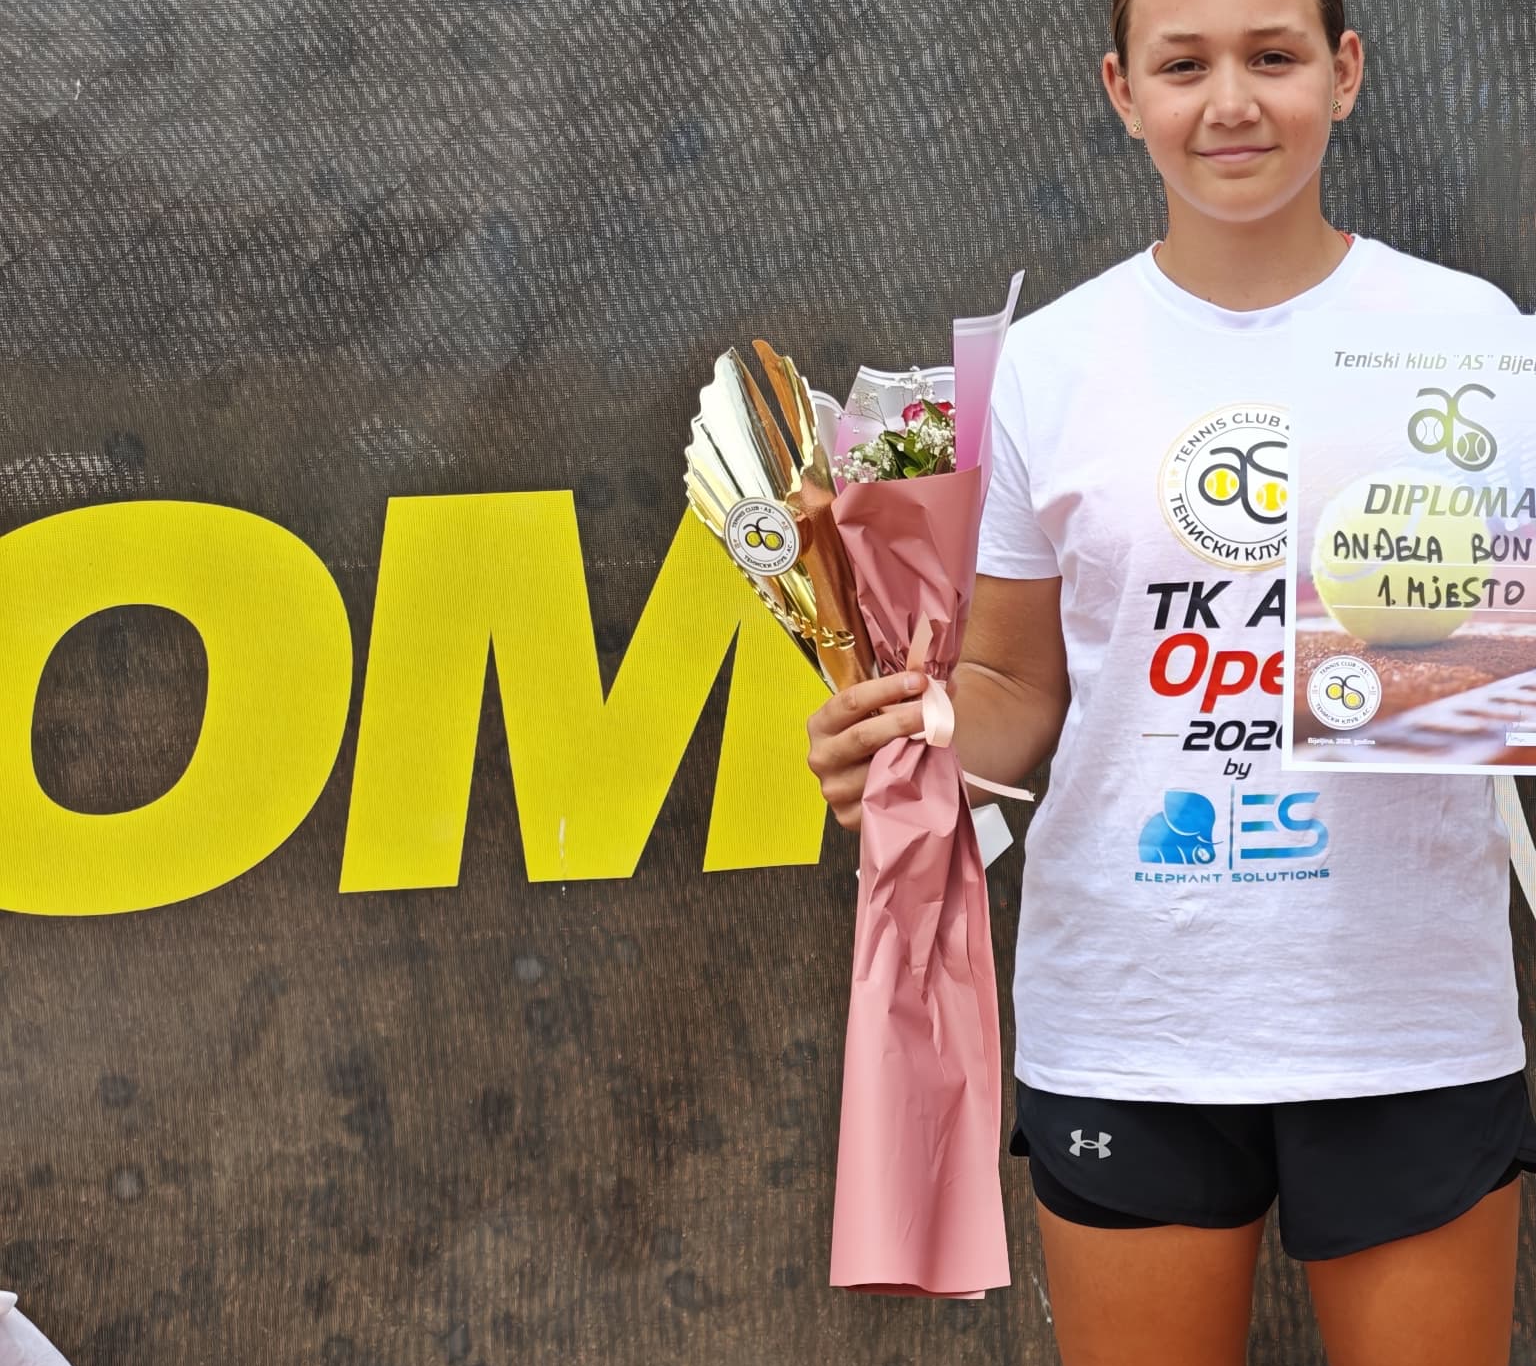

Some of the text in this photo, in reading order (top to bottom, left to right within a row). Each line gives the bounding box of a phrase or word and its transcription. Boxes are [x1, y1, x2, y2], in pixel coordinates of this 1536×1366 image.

[1333, 350, 1401, 370] Teniski
[1406, 352, 1448, 370] klub
[1174, 412, 1281, 464] TENNIS CLUB
[1170, 493, 1287, 562] ТЕНИСКИ КЛУ
[1147, 580, 1233, 630] TK
[1377, 575, 1396, 606] 1.
[1182, 720, 1282, 751] 202
[1223, 758, 1252, 780] by
[1240, 792, 1329, 860] ES
[1134, 868, 1330, 884] ELEPHANT SOLUTIONS
